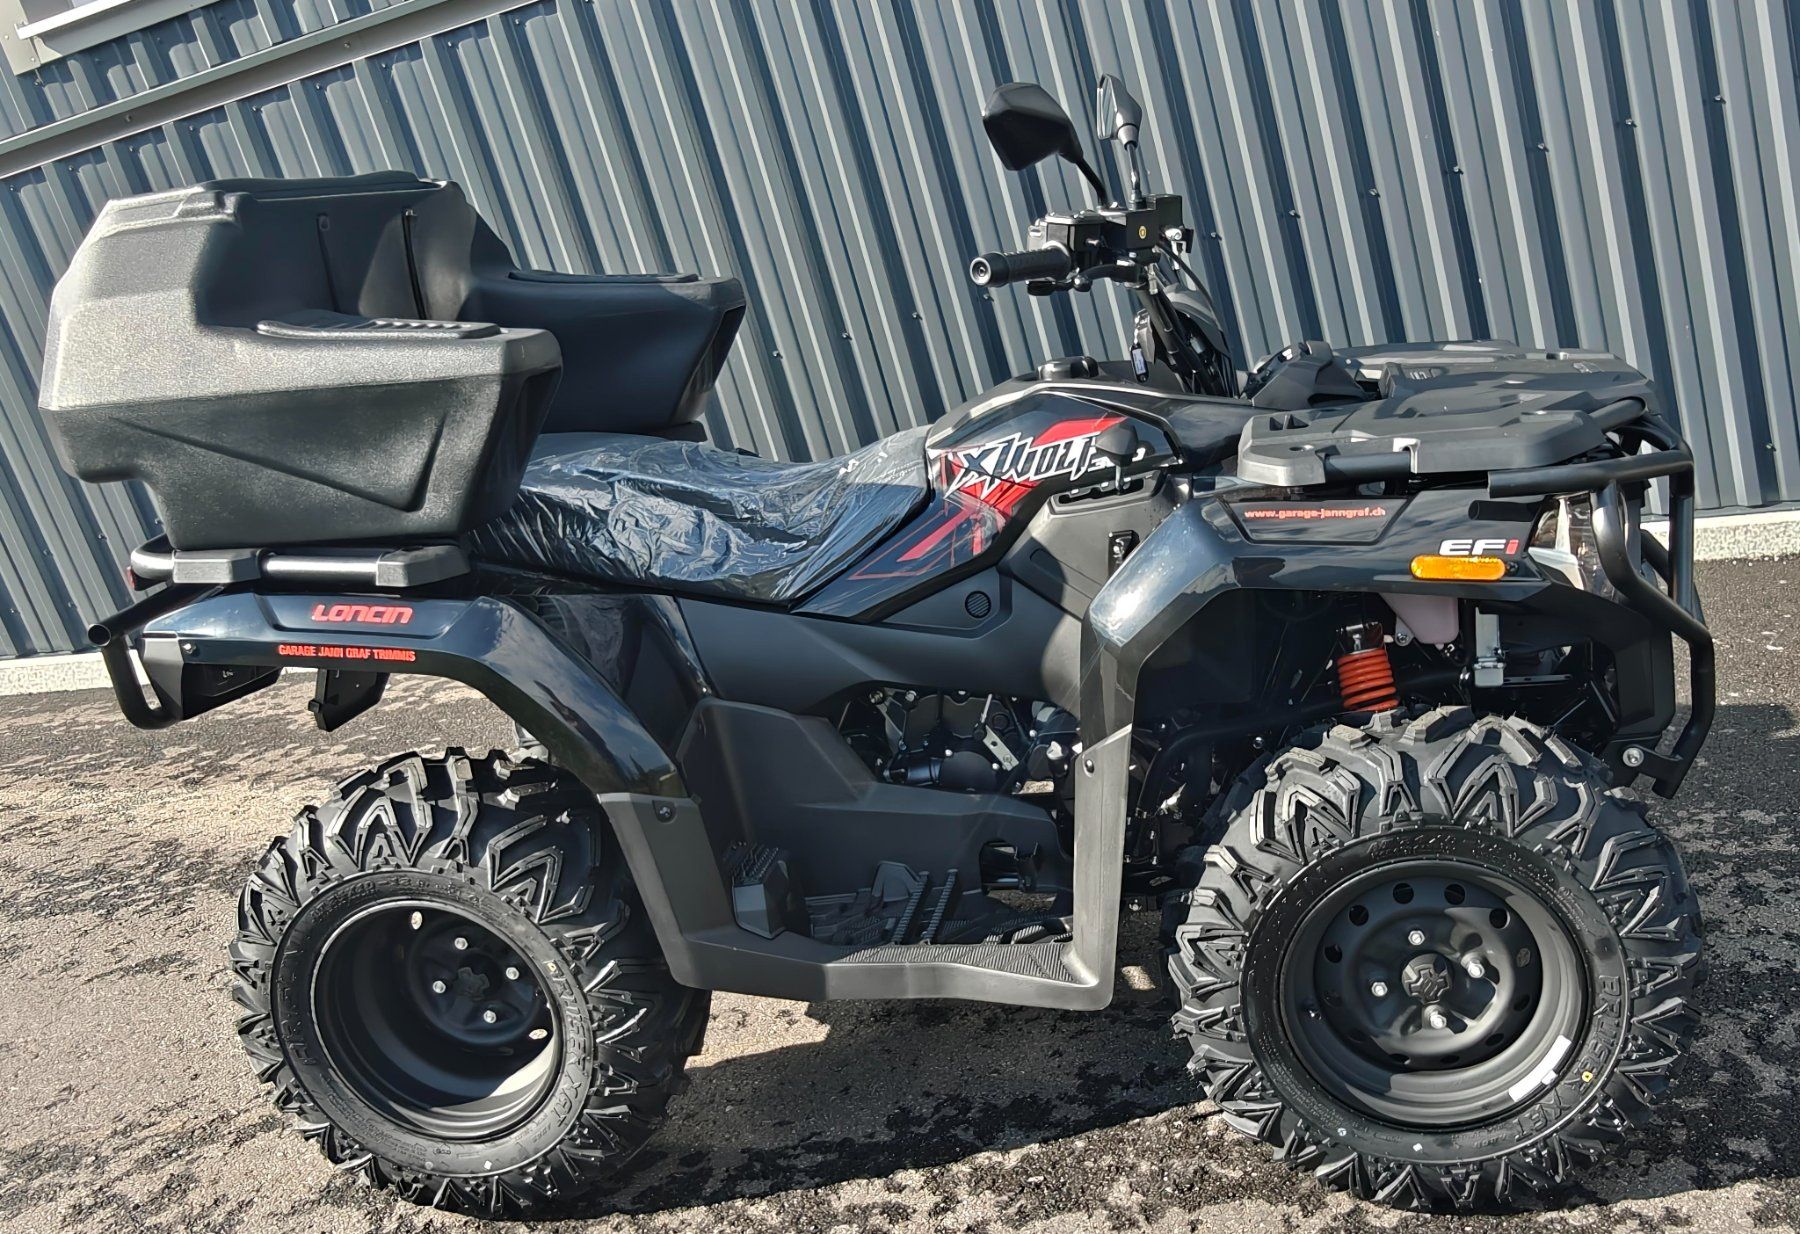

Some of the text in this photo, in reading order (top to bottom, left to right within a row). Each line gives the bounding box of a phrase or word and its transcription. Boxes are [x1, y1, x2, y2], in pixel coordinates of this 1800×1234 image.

[1244, 507, 1386, 519] www.garage-janngraf.ch
[311, 604, 413, 624] LONCIN
[278, 644, 317, 657] GARAGE
[345, 648, 372, 660] GRAF
